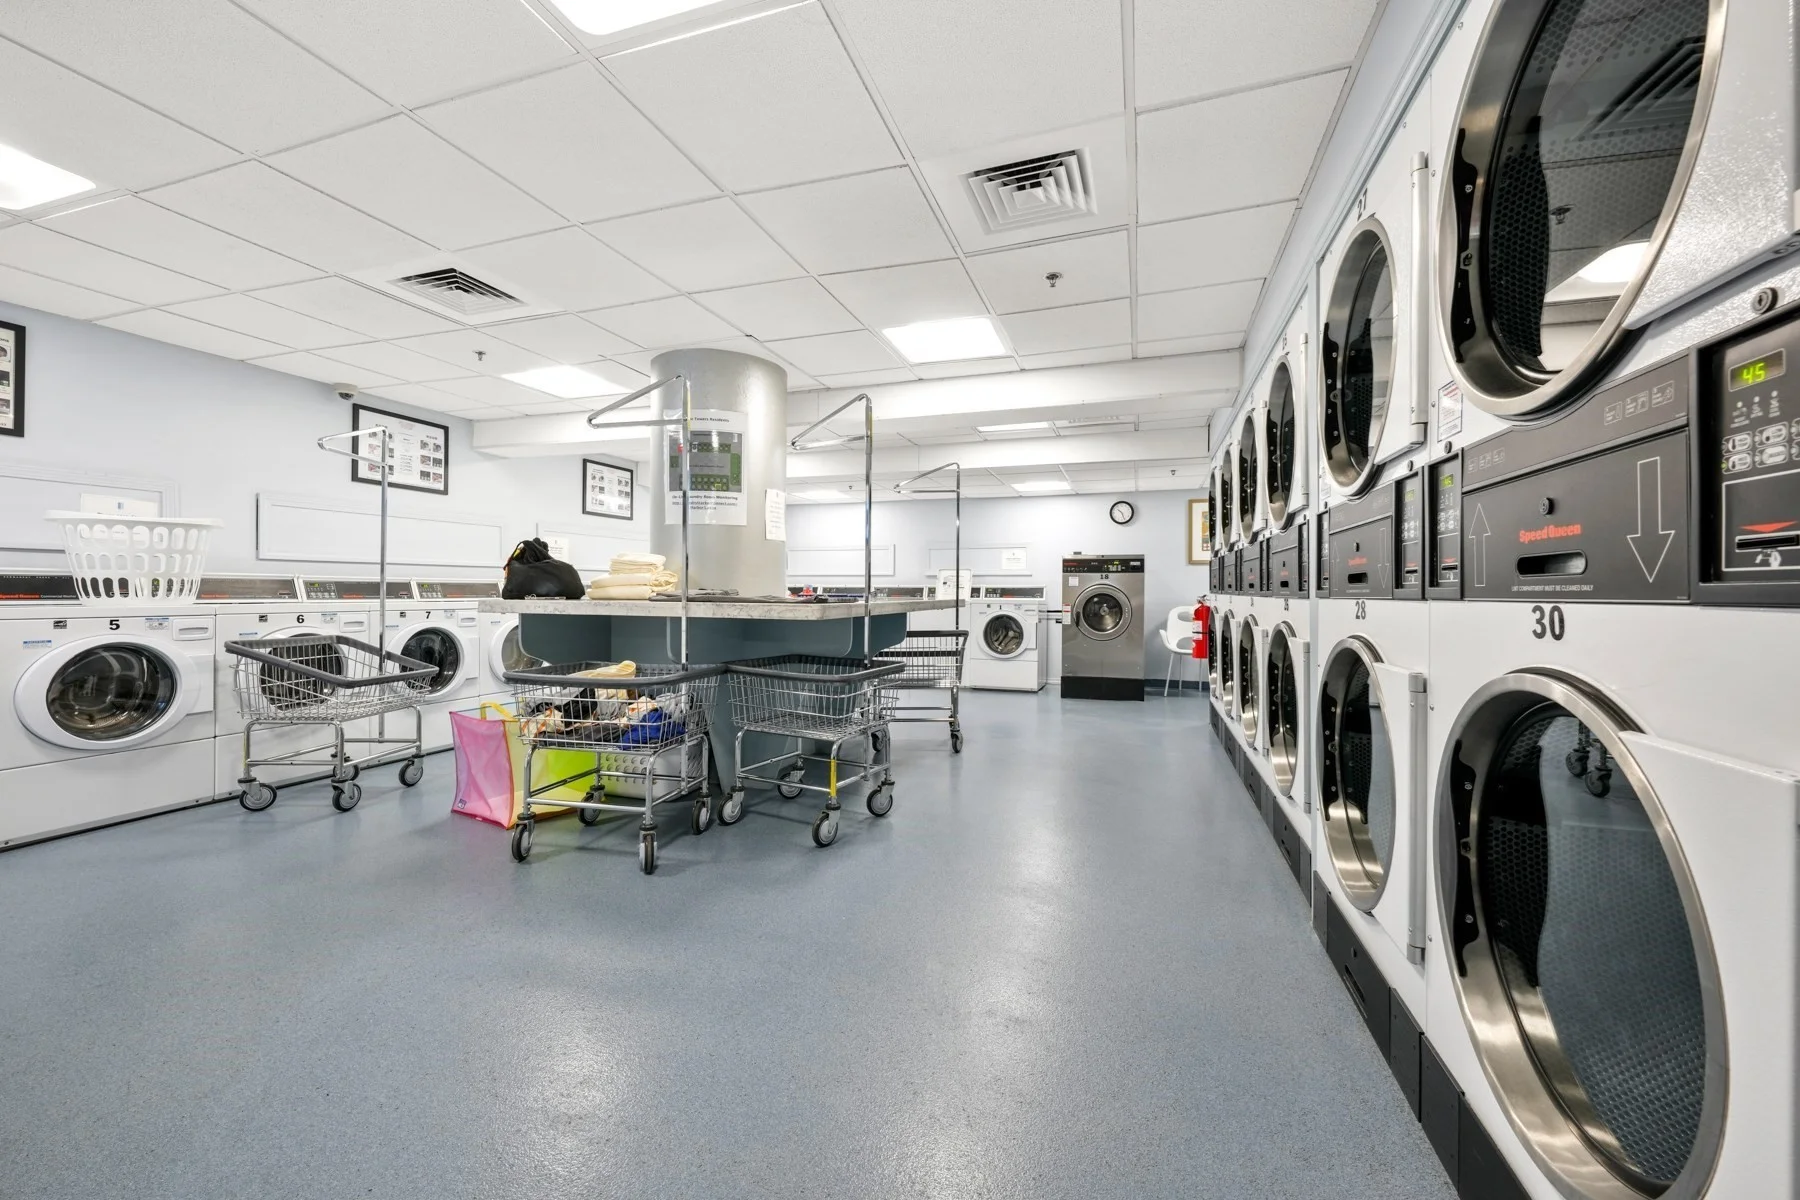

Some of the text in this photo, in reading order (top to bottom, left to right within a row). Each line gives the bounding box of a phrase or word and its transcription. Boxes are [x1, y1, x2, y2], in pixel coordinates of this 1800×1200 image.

[1743, 363, 1765, 384] 45
[1520, 524, 1581, 544] Speed Queen
[296, 614, 304, 624] 6
[1356, 600, 1366, 620] 28
[109, 619, 120, 630] 5
[1532, 604, 1565, 641] 30
